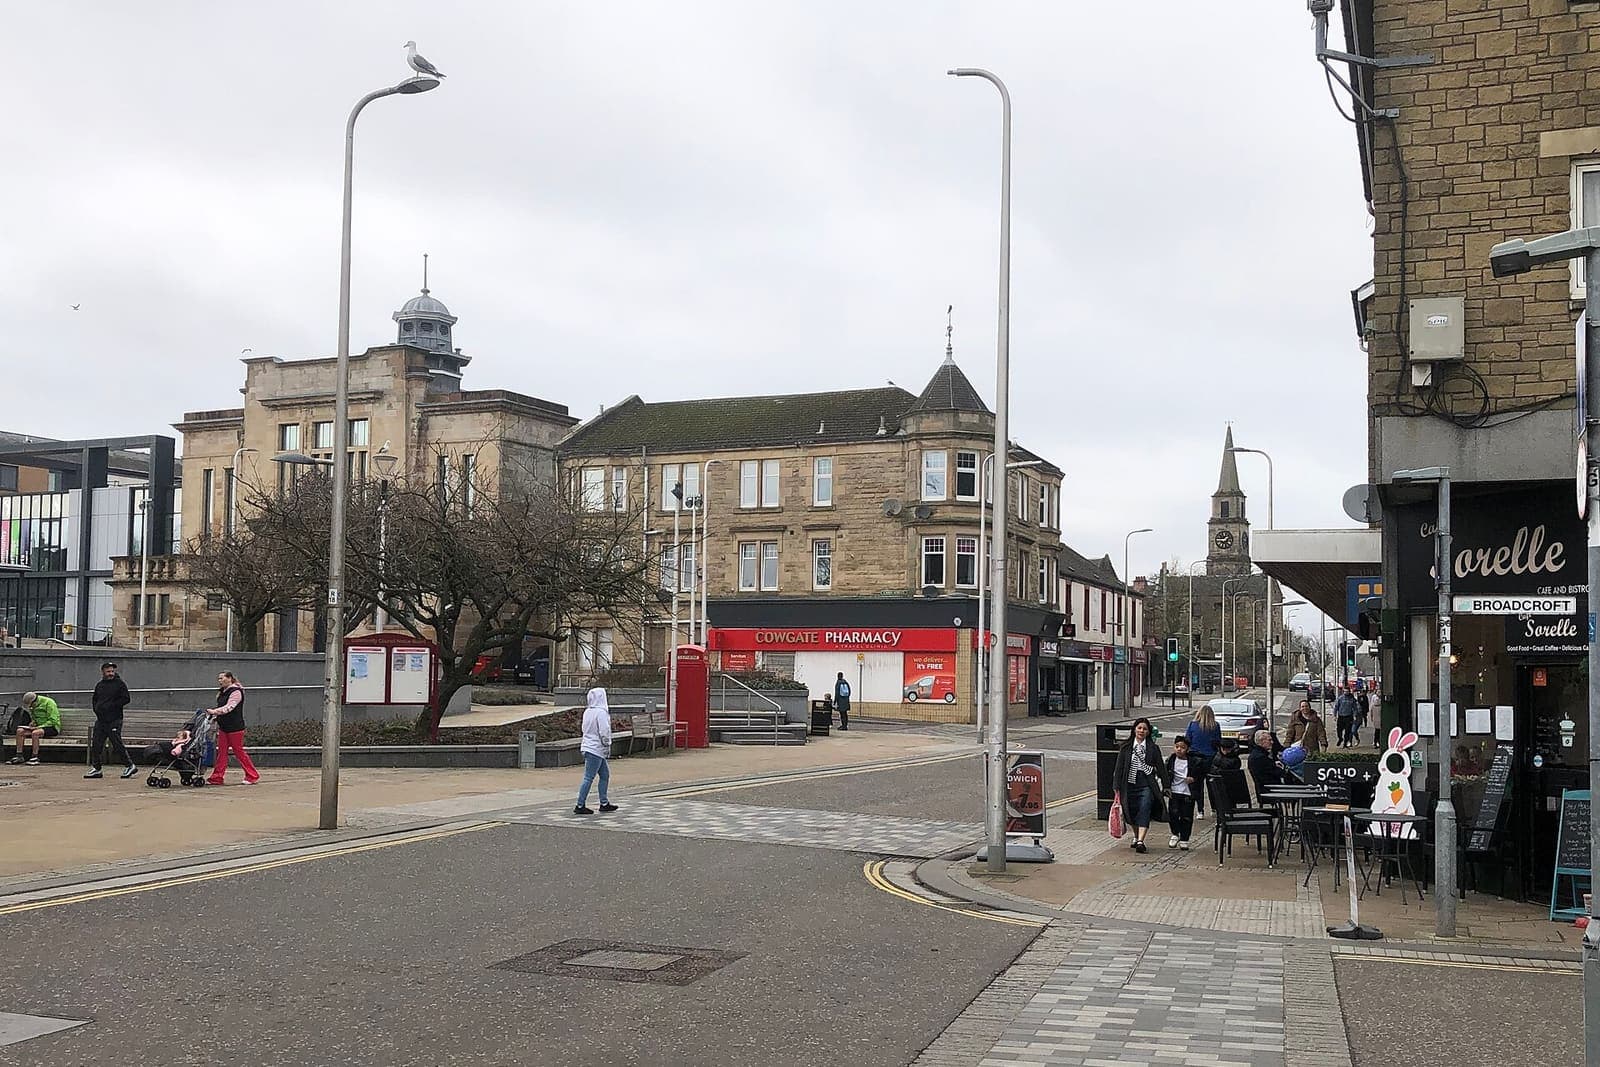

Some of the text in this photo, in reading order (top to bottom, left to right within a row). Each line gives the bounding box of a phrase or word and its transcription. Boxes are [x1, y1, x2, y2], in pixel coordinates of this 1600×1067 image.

[1420, 519, 1439, 538] Ca
[1454, 524, 1566, 578] orelle
[1537, 586, 1552, 595] CAFE
[1553, 586, 1567, 594] AND
[1473, 599, 1571, 612] BROADCROFT
[1525, 618, 1578, 637] Sorelle
[755, 631, 902, 646] COWGATE PHARMACY
[1007, 775, 1037, 783] DWICH
